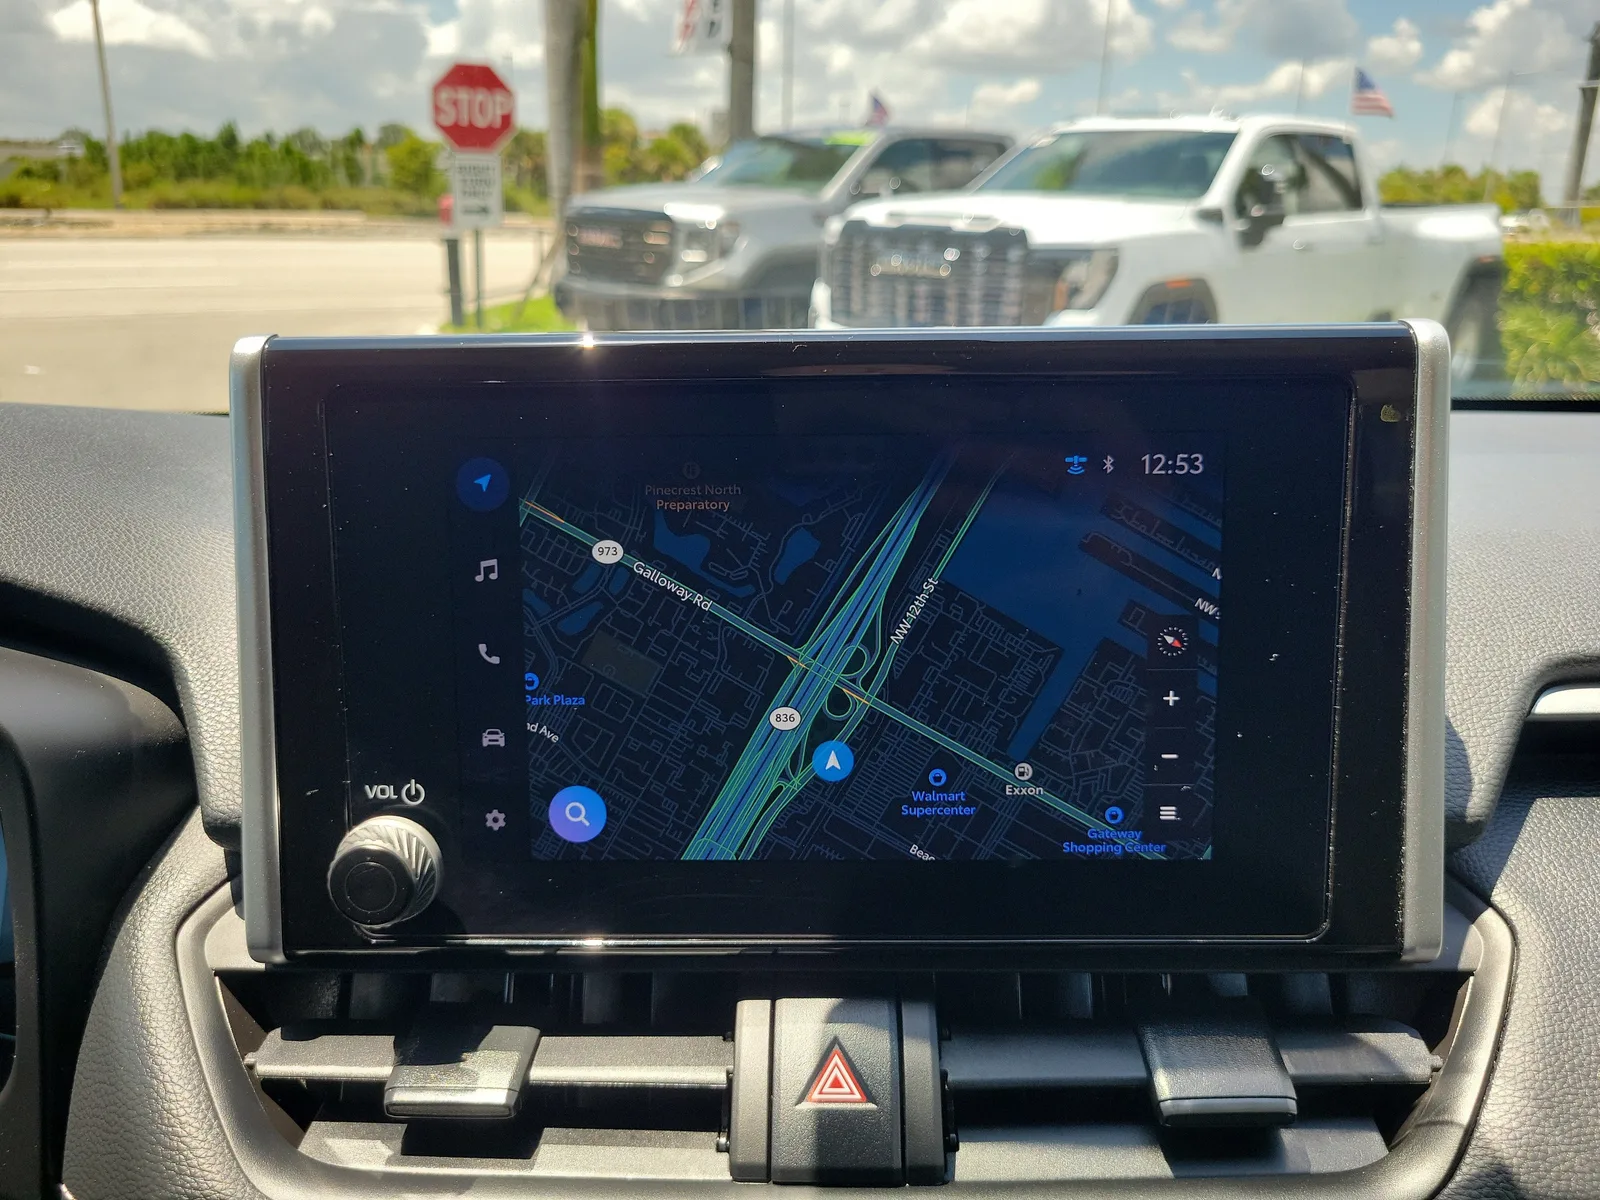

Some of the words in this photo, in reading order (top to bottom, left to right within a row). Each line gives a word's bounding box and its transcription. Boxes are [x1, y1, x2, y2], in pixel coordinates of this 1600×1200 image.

[436, 85, 513, 128] STOP
[1141, 453, 1204, 475] 12:53
[645, 484, 702, 496] Pinecrest
[705, 484, 741, 495] North
[656, 500, 730, 512] Preparatory
[597, 546, 618, 556] 973
[633, 561, 693, 601] Galloway
[693, 593, 713, 612] Rd
[890, 618, 911, 644] NW
[906, 593, 929, 619] 12th
[923, 577, 938, 593] St
[525, 694, 551, 705] Park
[553, 694, 585, 705] Plaza
[775, 713, 795, 722] 836
[538, 725, 559, 743] Ave
[364, 784, 398, 799] VOL
[911, 790, 966, 801] Walmart
[1005, 784, 1044, 795] Exxon
[901, 805, 976, 818] Supercenter
[1087, 828, 1142, 840] Gateway
[1063, 841, 1122, 855] Shopping
[1124, 841, 1167, 853] Center
